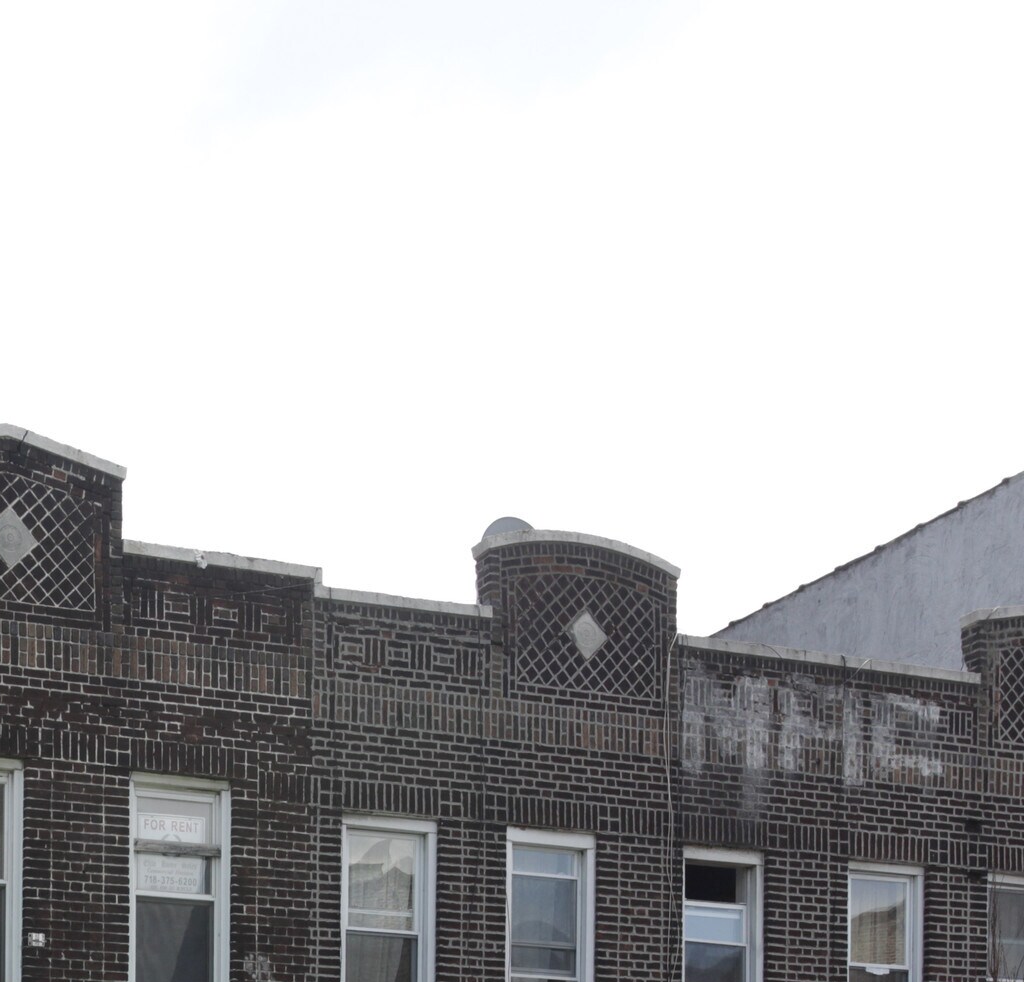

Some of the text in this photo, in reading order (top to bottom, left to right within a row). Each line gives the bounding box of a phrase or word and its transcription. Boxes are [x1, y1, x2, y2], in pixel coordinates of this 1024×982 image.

[144, 818, 199, 833] FOR RENT
[144, 875, 198, 887] 718-375-6200
